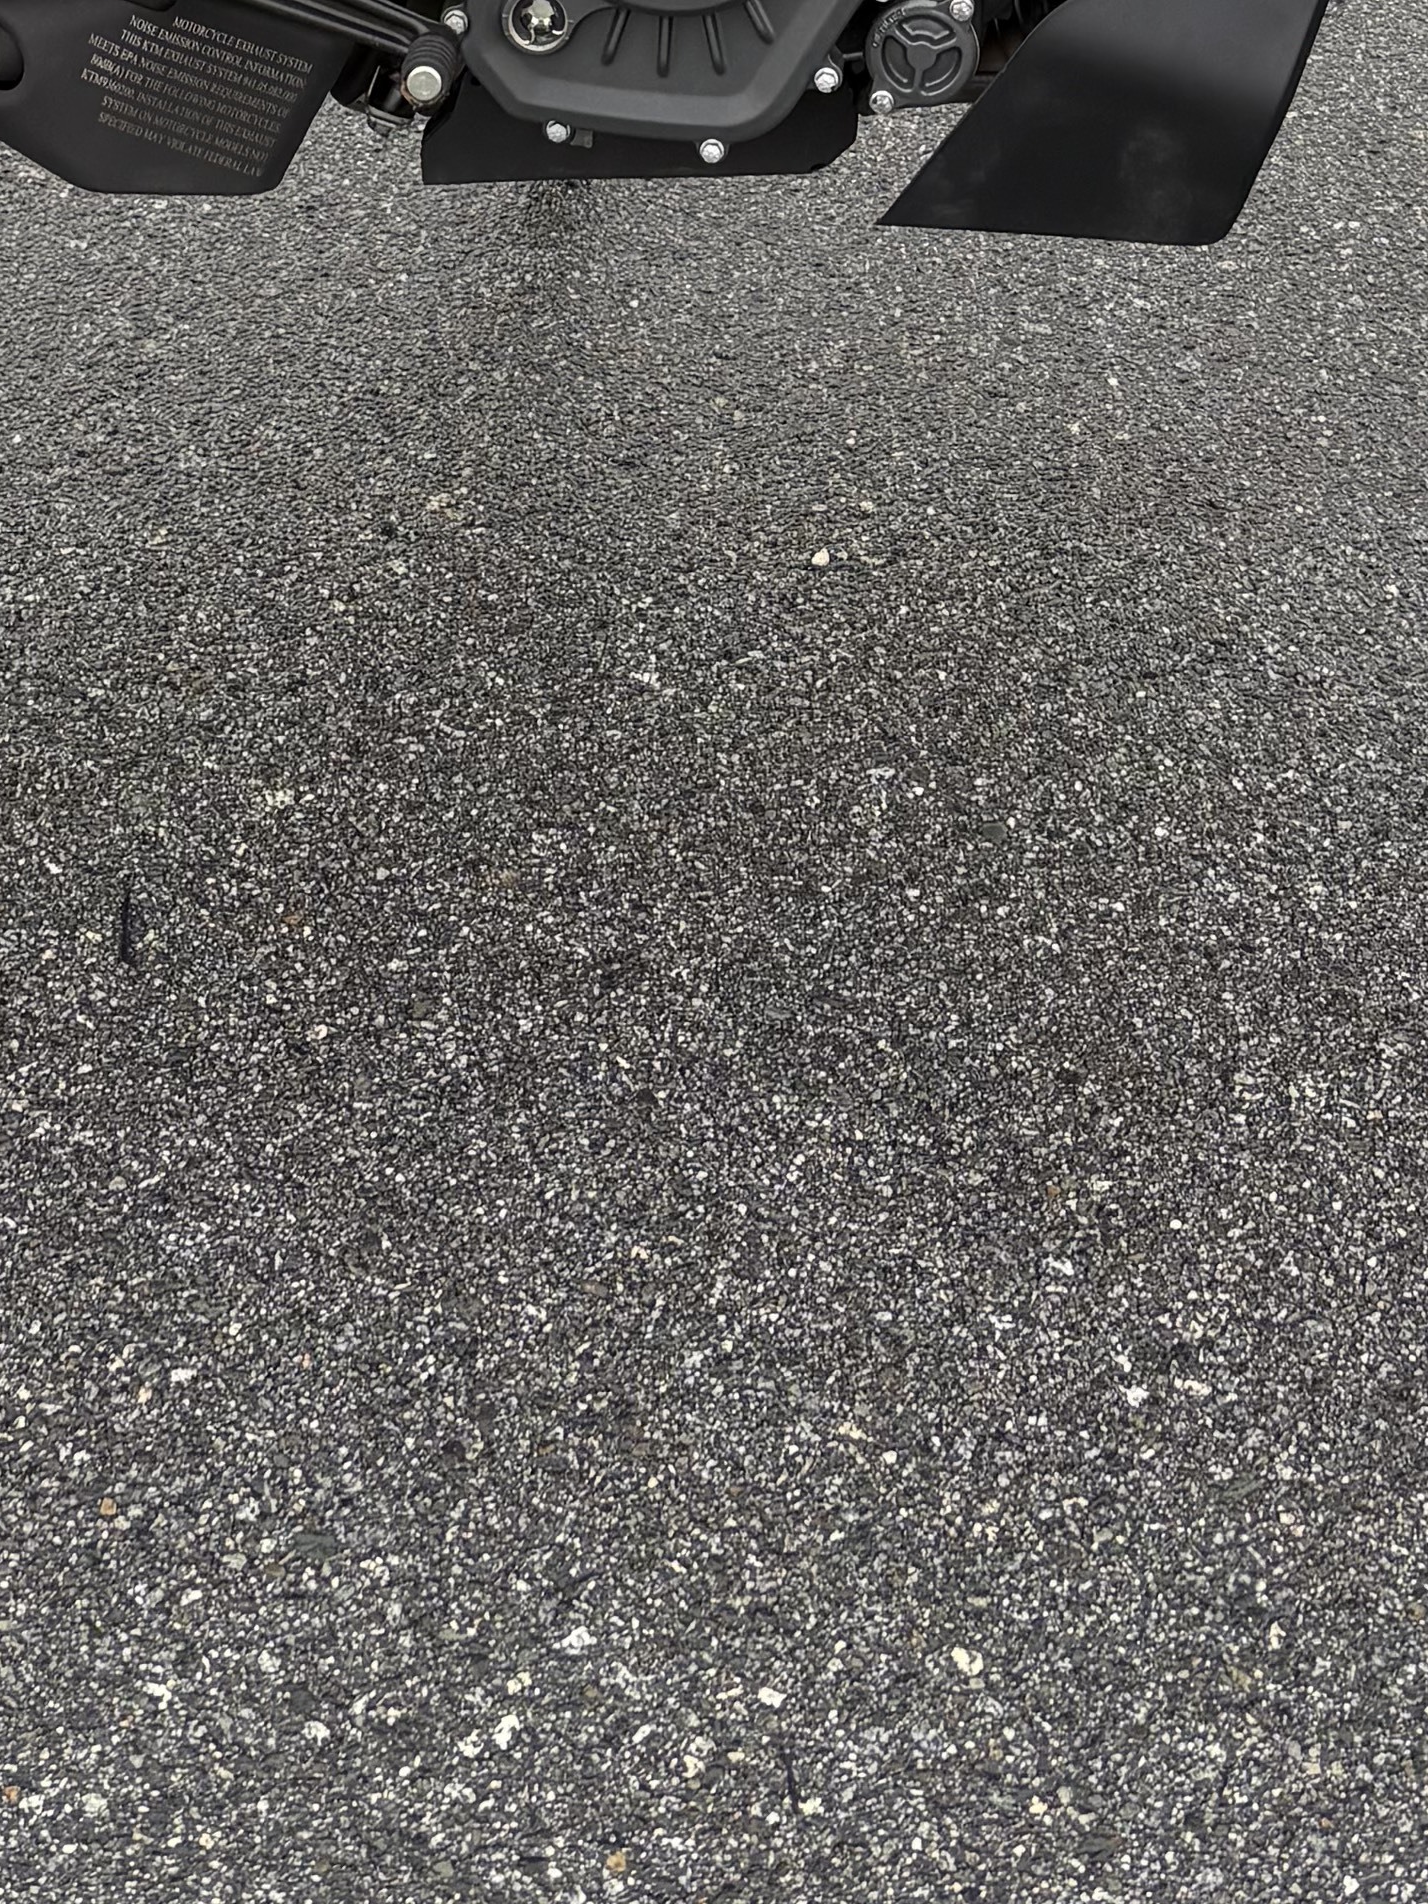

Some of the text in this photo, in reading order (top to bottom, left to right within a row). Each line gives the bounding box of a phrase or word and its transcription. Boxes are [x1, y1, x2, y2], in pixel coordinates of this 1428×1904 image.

[89, 33, 119, 56] MEETS
[122, 50, 137, 65] EPA
[140, 57, 167, 78] NOISE
[167, 68, 209, 92] EMISSION
[121, 29, 141, 48] THIS
[144, 38, 164, 56] KTM
[164, 48, 205, 73] EXHAUST
[207, 64, 242, 83] SYSTEM
[130, 15, 307, 89] NOISE EMISSION CONTROL INFORMATION
[173, 16, 313, 74] MOTORCYCLE EXHAUST SYSTEM
